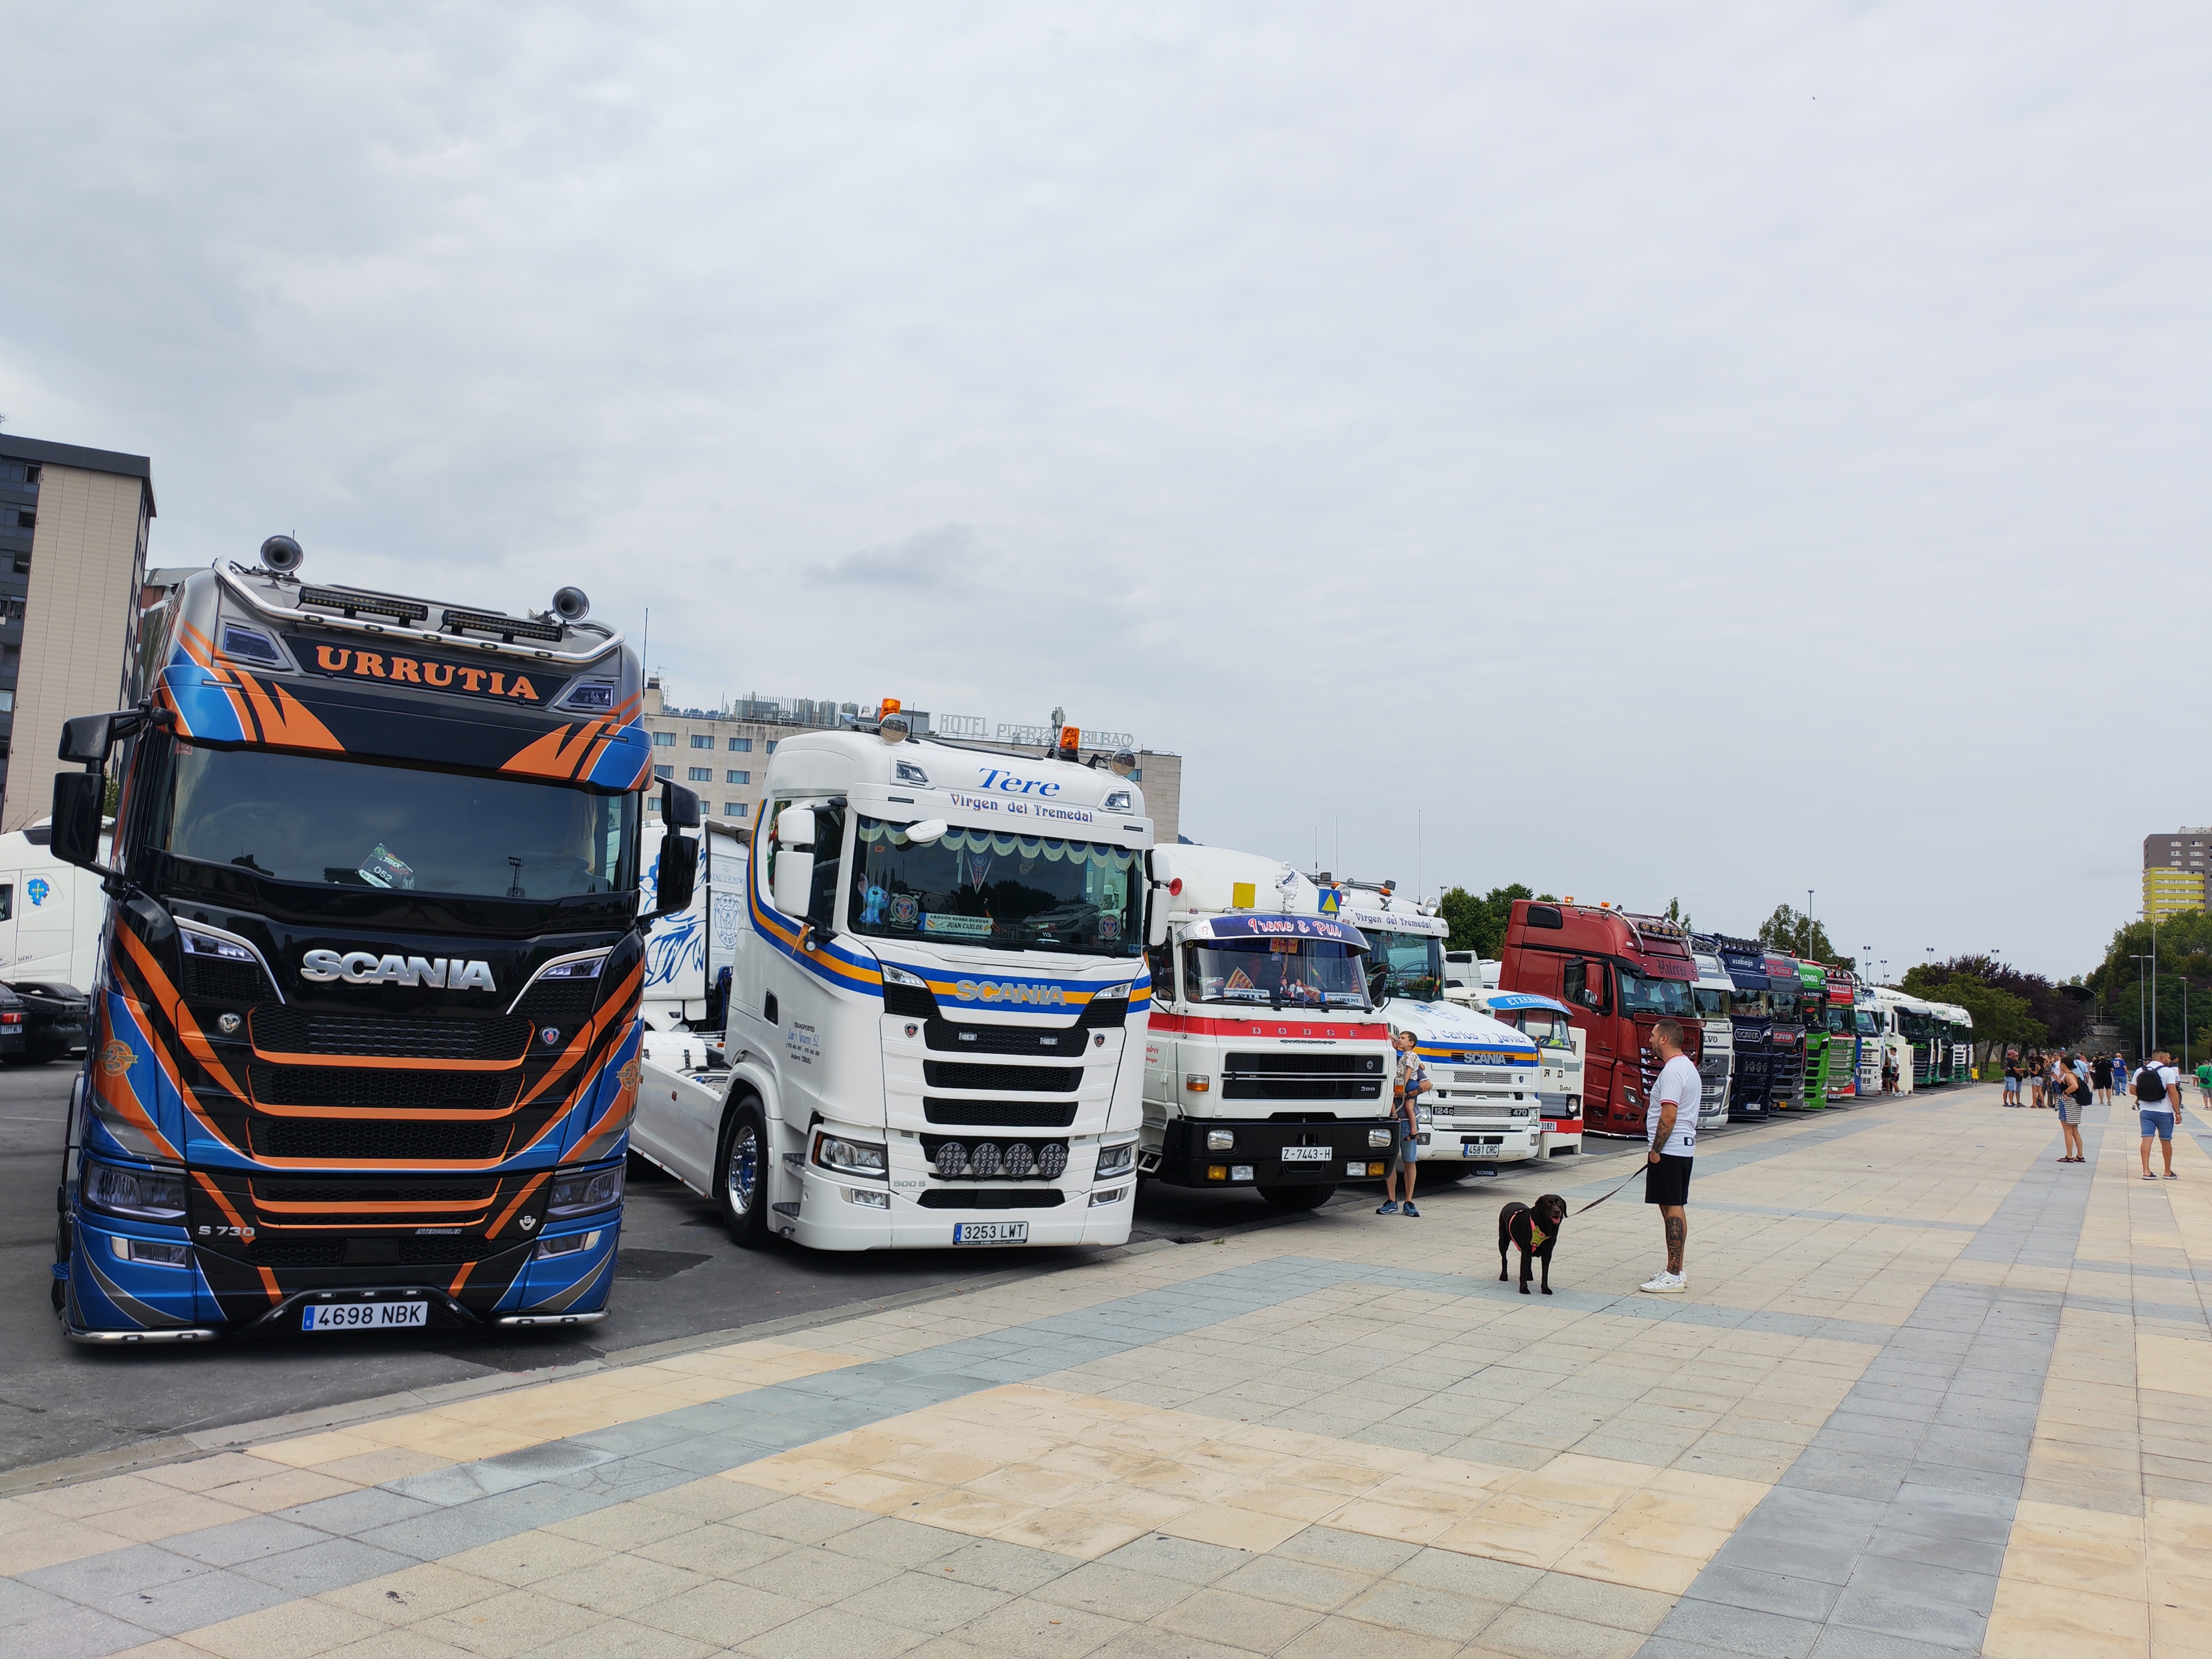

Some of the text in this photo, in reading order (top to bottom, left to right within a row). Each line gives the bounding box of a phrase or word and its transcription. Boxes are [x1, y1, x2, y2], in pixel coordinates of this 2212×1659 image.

[316, 645, 539, 700] URRUTIA
[940, 714, 1134, 747] HOTEL PUERTA BILBAO
[978, 768, 1060, 797] Tere
[950, 793, 1093, 823] Virgen del Tremedal
[374, 866, 392, 882] 052
[1248, 918, 1341, 938] Irene & Pili
[1354, 913, 1432, 929] Virgen del Tremedal
[300, 949, 497, 992] SCANIA
[1656, 959, 1687, 976] Valeria
[1732, 958, 1753, 968] usabiaga
[1799, 974, 1818, 982] ALONSO
[955, 980, 1067, 1006] SCANIA
[794, 1022, 815, 1033] TRANSPORTES
[1252, 1027, 1358, 1037] DODGE
[1737, 1030, 1759, 1040] SCANIA
[1425, 1029, 1527, 1044] J. Carlos y Javier
[1773, 1032, 1793, 1041] SCANIA
[1146, 1044, 1159, 1054] ndrés
[1464, 1053, 1506, 1064] SCANIA
[1684, 1137, 1694, 1146] D
[1284, 1149, 1330, 1159] Z-7443-H
[1469, 1145, 1497, 1155] 4581 CRC
[198, 1225, 255, 1237] S 730
[965, 1225, 996, 1239] 3253
[1001, 1224, 1024, 1238] LWT
[319, 1306, 374, 1325] 4698
[382, 1305, 422, 1324] NBK
